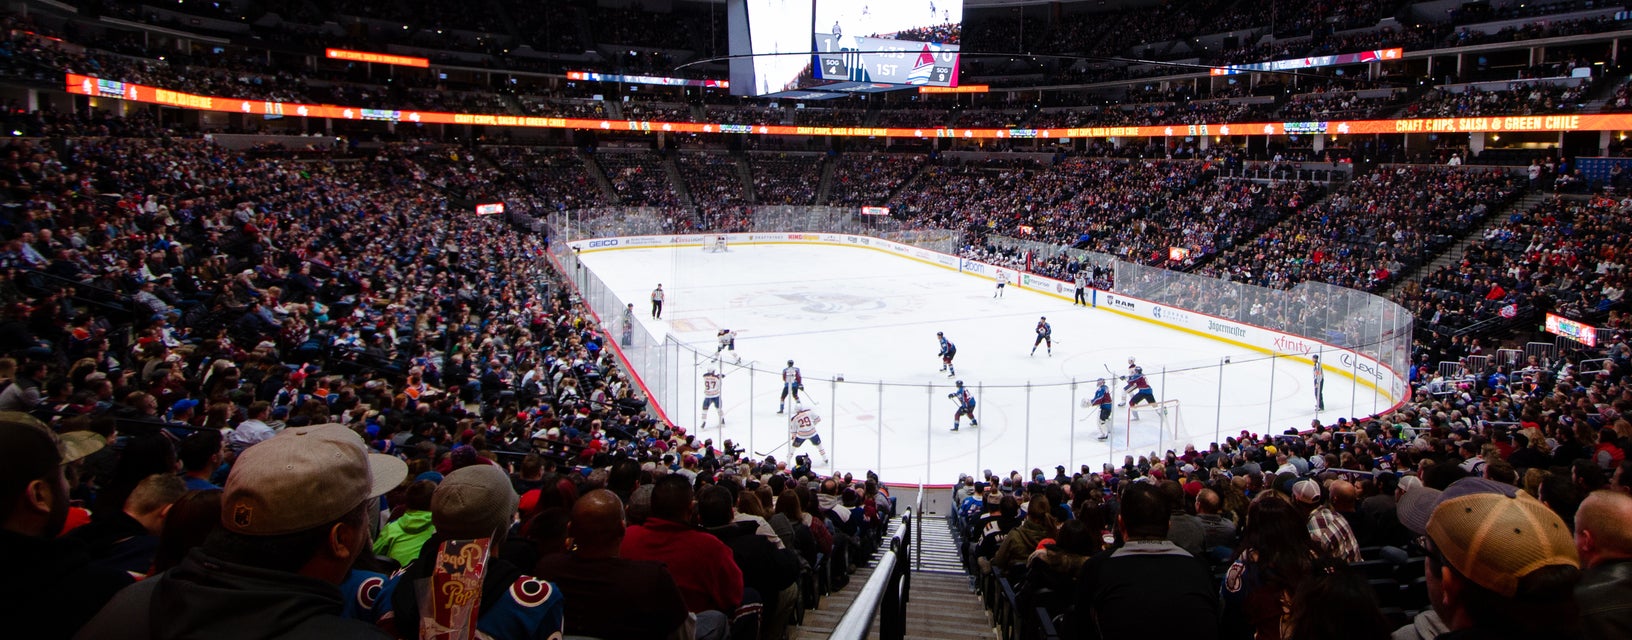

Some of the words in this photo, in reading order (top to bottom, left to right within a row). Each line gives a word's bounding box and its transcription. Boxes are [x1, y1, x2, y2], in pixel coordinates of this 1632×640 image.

[824, 38, 831, 52] 1
[829, 67, 836, 75] 4
[877, 64, 898, 76] 1ST
[938, 74, 945, 82] 9
[1396, 120, 1423, 131] CRAFT
[1426, 119, 1456, 132] CHIPS,
[1459, 119, 1488, 130] SALSA
[1491, 118, 1501, 129] &
[1504, 117, 1541, 129] GREEN
[1545, 116, 1578, 129] CHILE
[589, 239, 618, 248] GEICO
[1115, 299, 1135, 308] RAM
[1274, 335, 1312, 356] xfinity
[1353, 359, 1383, 380] LEXUS
[704, 380, 716, 391] 97
[798, 416, 812, 428] 29
